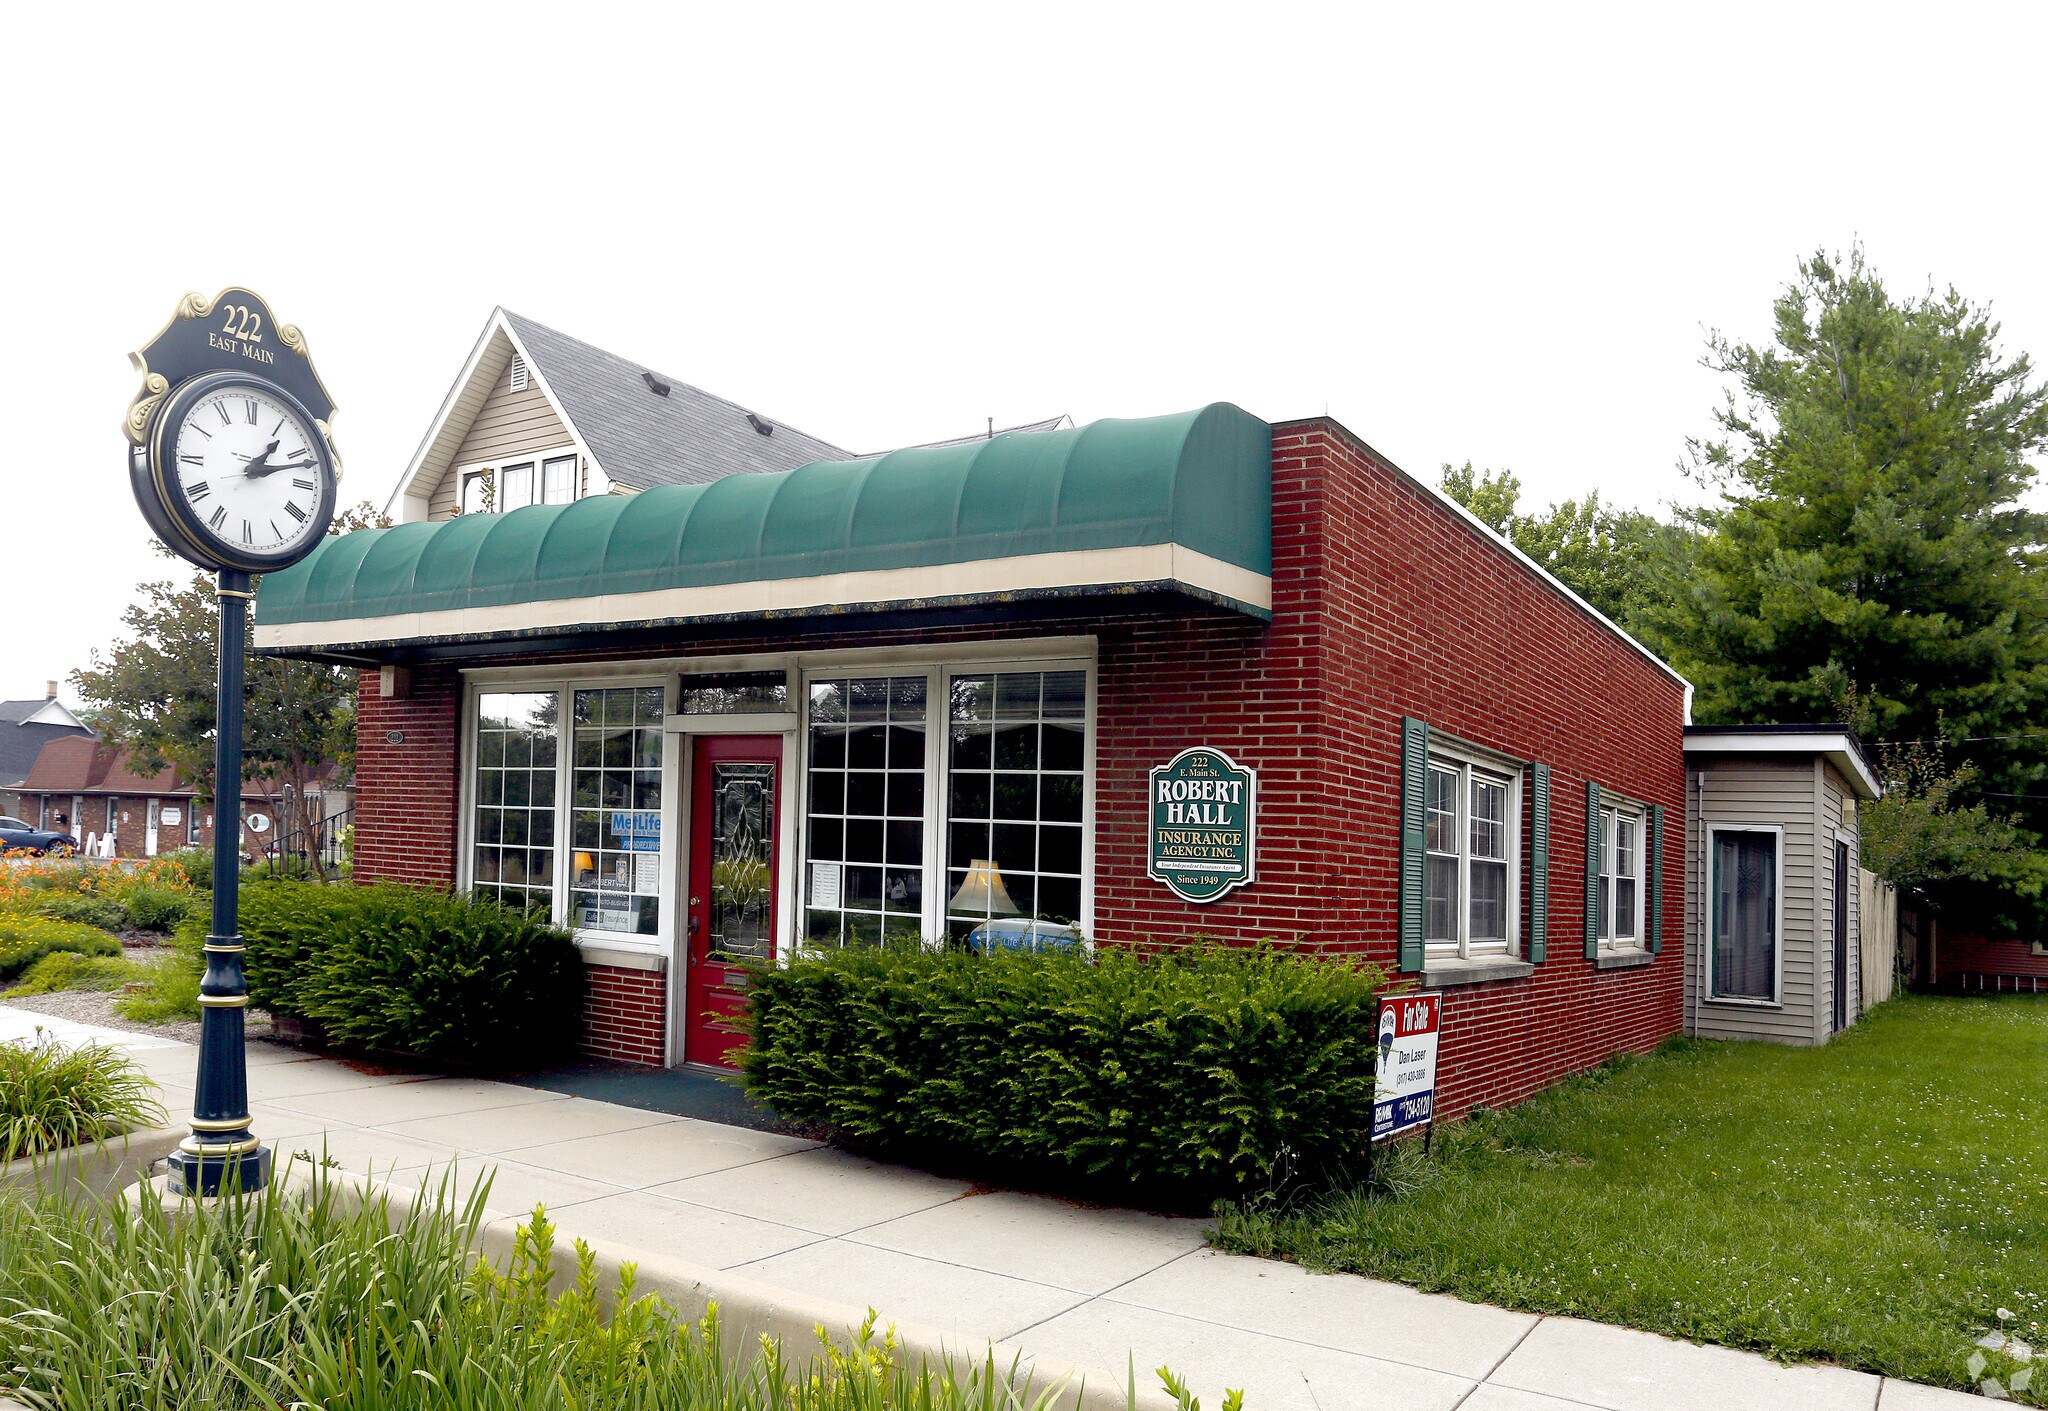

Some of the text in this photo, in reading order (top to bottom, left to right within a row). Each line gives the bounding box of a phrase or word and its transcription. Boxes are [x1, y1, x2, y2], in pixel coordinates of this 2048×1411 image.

[223, 304, 262, 342] 222
[209, 332, 274, 364] EAST MAIN
[1191, 757, 1209, 768] 222
[1180, 769, 1220, 778] E. Main St.
[1157, 779, 1243, 805] ROBERT
[613, 812, 661, 830] MetLife
[1166, 803, 1233, 825] HALL
[1157, 831, 1242, 846] INSURANCE
[1162, 845, 1236, 859] AGENCY INC.
[1176, 874, 1219, 885] Since 1949
[1402, 1001, 1429, 1032] For Sale
[1398, 1048, 1426, 1065] Dan Laser
[1404, 1095, 1431, 1121] 754-5120
